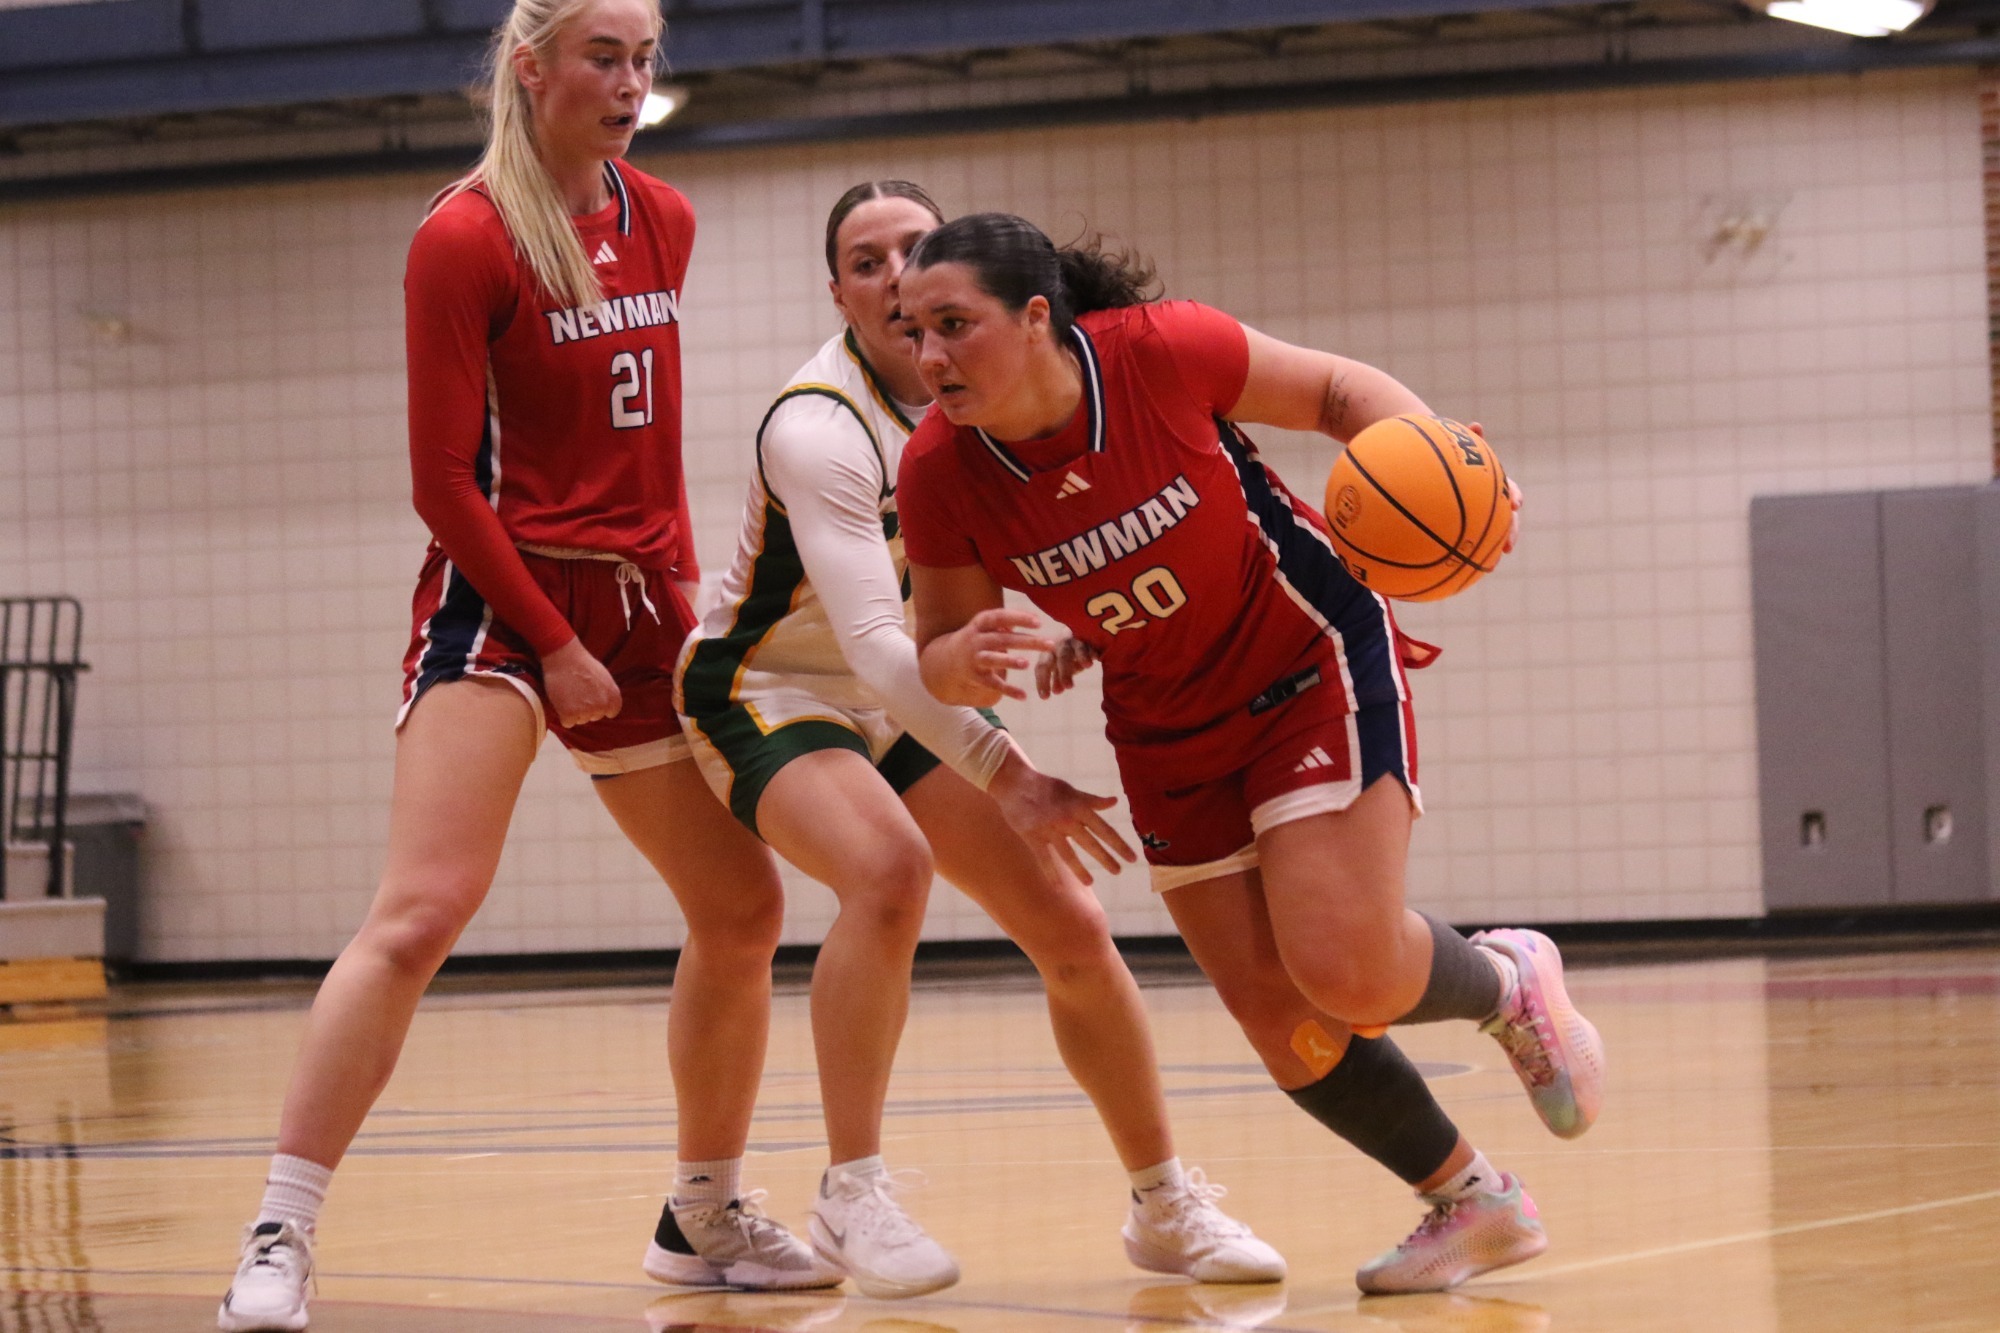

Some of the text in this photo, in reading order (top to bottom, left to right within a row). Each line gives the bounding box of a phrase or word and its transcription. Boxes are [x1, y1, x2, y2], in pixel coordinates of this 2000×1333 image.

[543, 289, 679, 345] NEWMAN
[611, 348, 653, 429] 21
[1007, 473, 1200, 587] NEWMAN
[1086, 566, 1188, 636] 20
